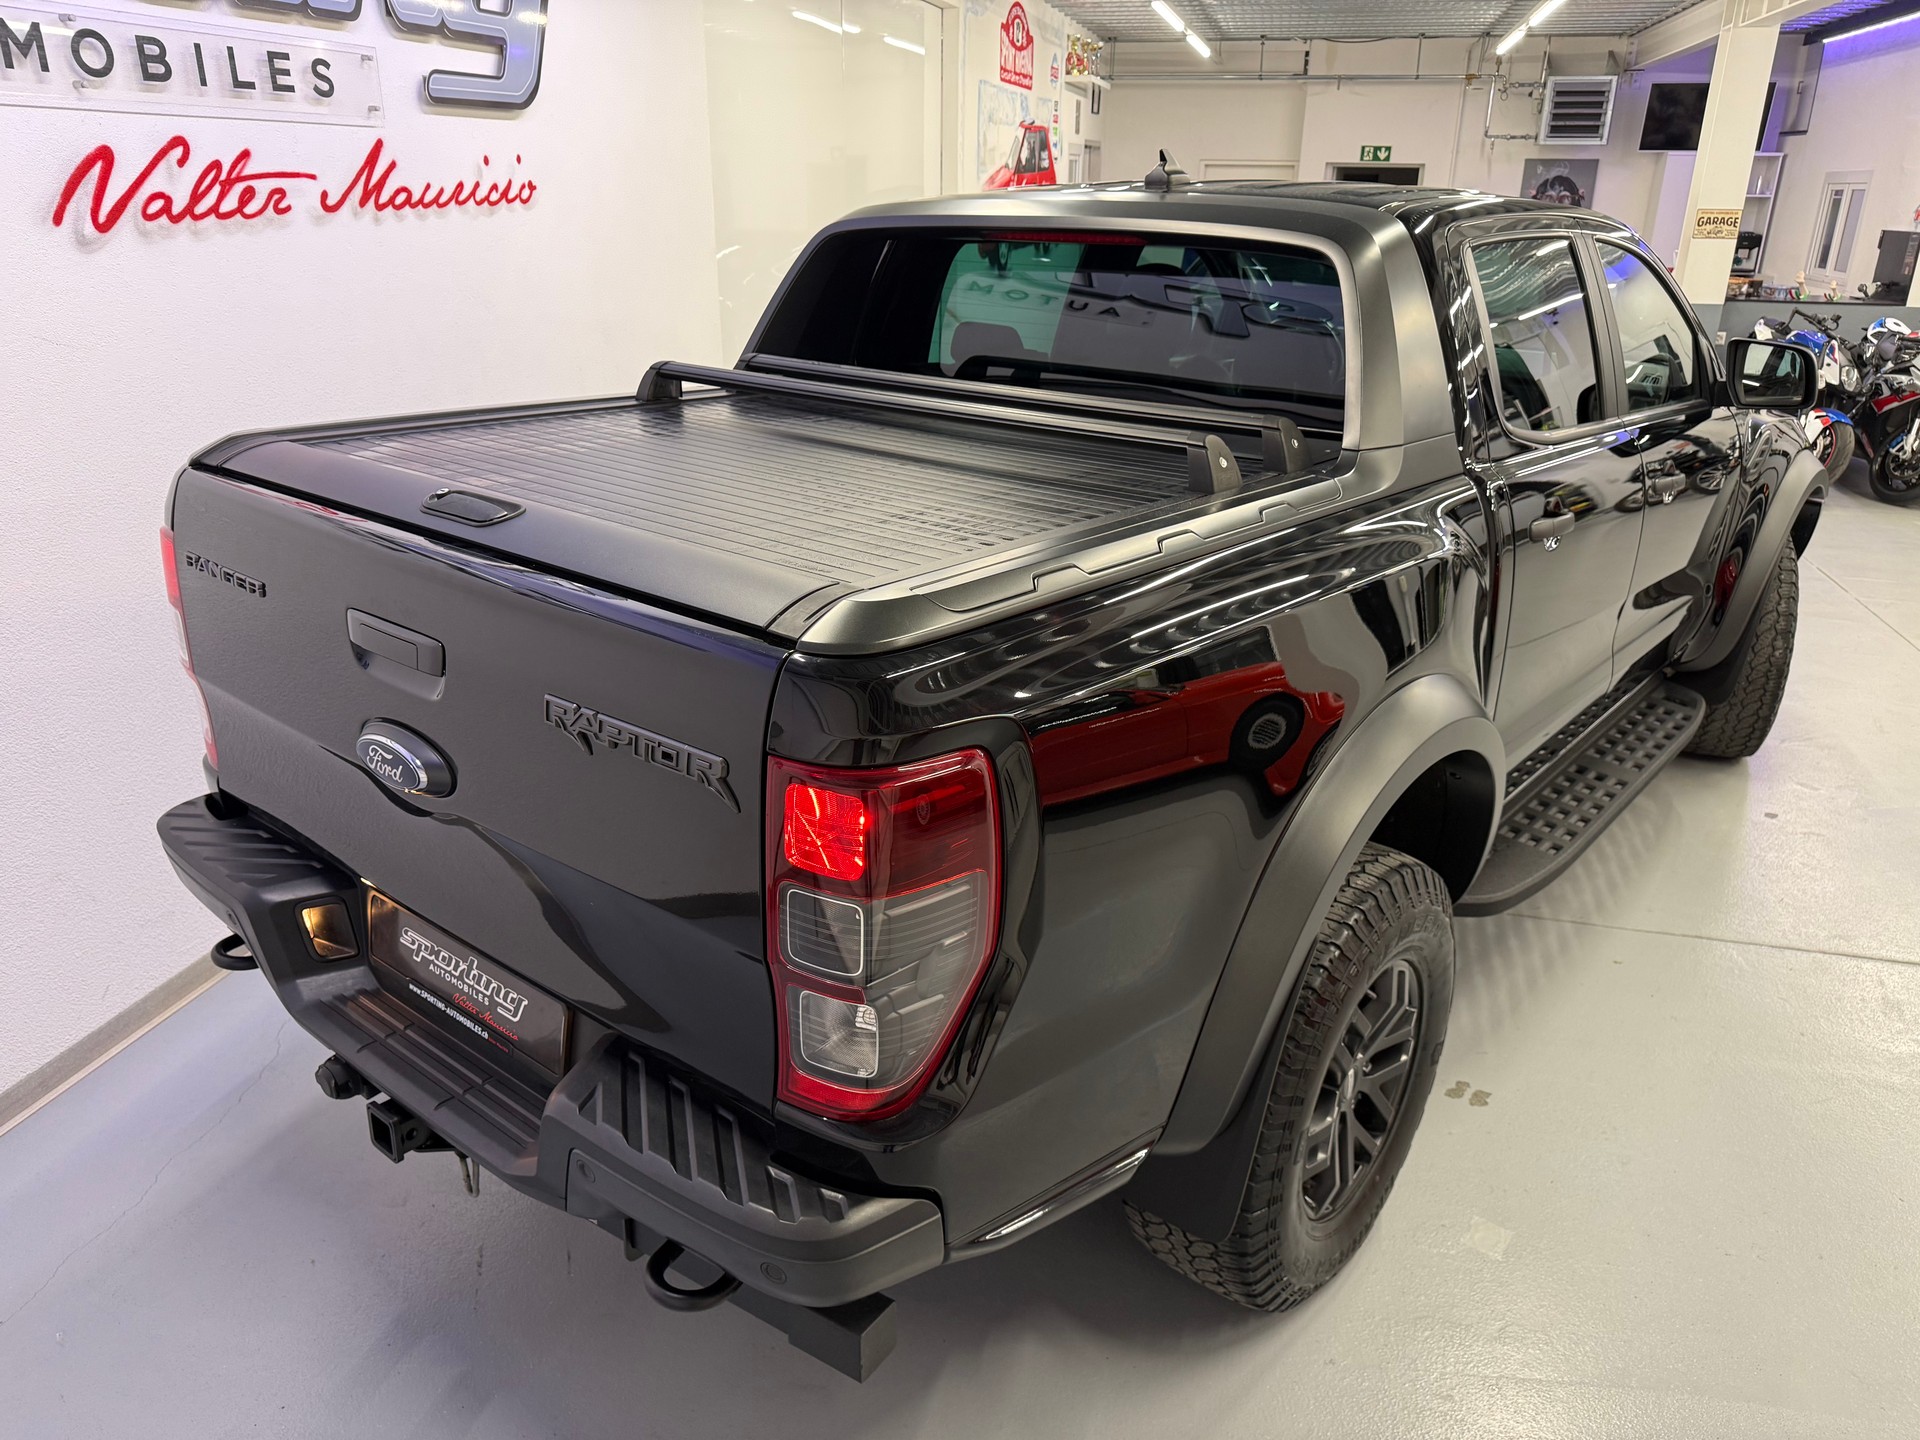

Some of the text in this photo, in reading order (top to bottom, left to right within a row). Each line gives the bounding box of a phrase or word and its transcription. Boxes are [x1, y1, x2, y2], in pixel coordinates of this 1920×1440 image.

[320, 137, 537, 214] Mauricio
[1697, 216, 1740, 229] GARAGE
[185, 550, 267, 598] RANGER
[366, 744, 403, 783] Ford
[544, 693, 741, 814] RAPTOR
[428, 963, 490, 1006] AUTOMOBILES
[408, 982, 489, 1040] www.SPORTING-AUTOMOBILES.ch
[452, 993, 519, 1041] Valter Mauricio
